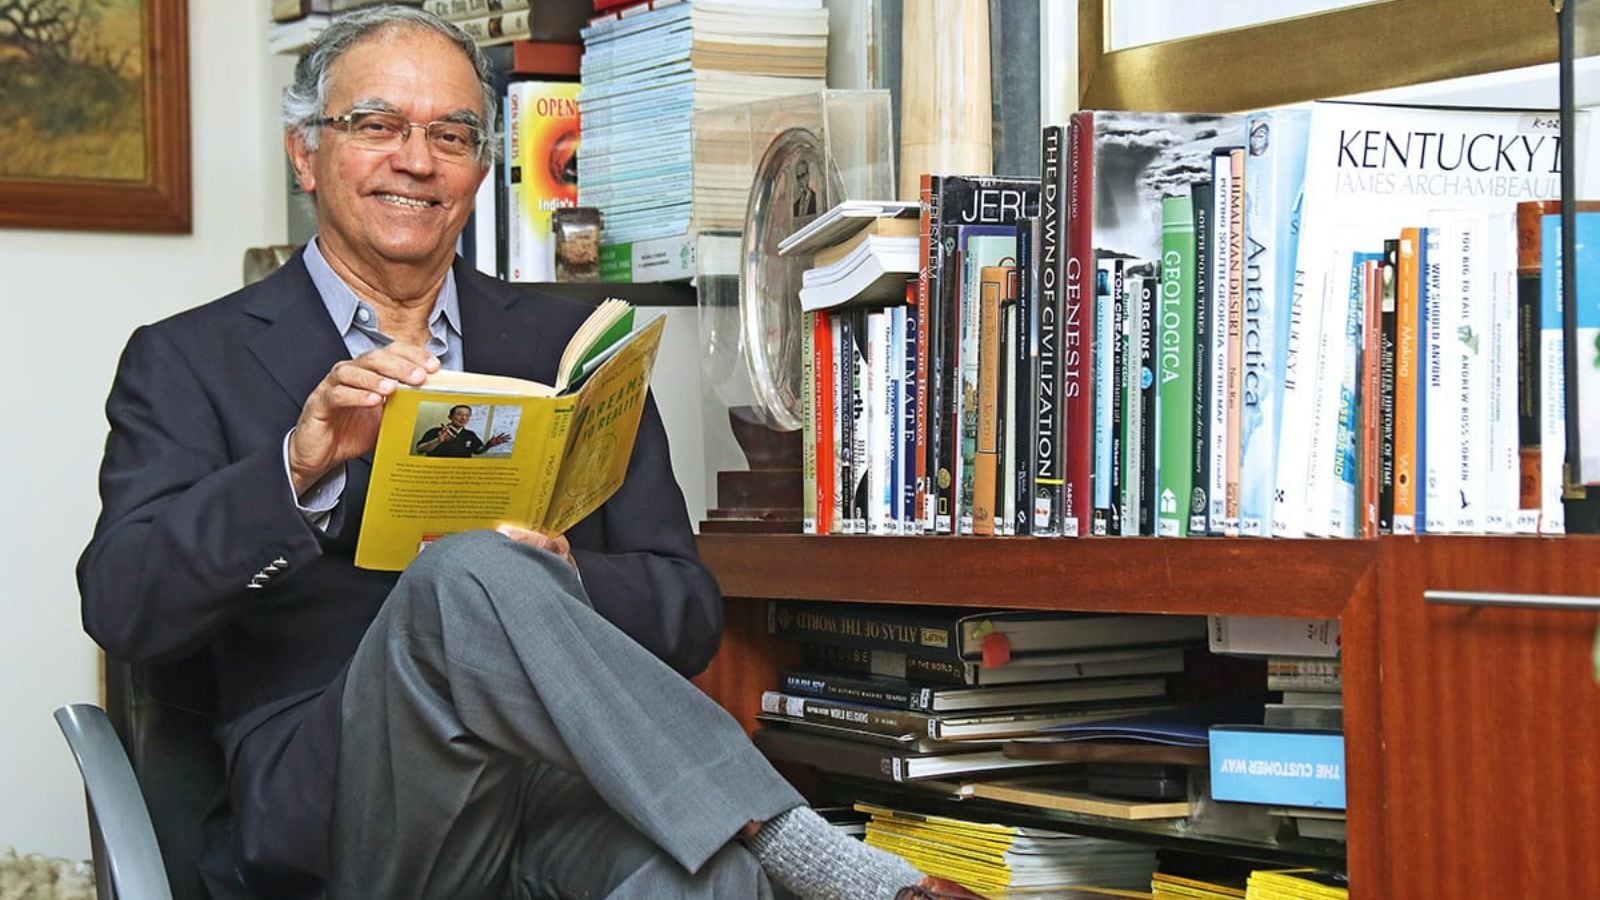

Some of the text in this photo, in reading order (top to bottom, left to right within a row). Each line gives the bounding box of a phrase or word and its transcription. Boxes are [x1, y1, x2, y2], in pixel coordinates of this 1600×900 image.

[1338, 130, 1545, 173] KENTUCKY
[1219, 177, 1228, 227] PUTTING
[1336, 174, 1396, 198] JAMES
[1197, 209, 1206, 335] SOUTH POLAR TIMES
[1217, 232, 1228, 279] SOUTH
[1229, 175, 1242, 339] HIMALAYAN DESERT
[1461, 230, 1471, 320] TOO BIG TO FAIL
[918, 266, 928, 331] WILDLIFE
[1038, 132, 1057, 478] THE DAWN OF CIVILIZATION
[1114, 270, 1123, 302] TOM
[1065, 257, 1081, 398] GENESIS
[1113, 303, 1122, 352] CREAN
[1141, 288, 1152, 359] ORIGINS
[1162, 250, 1182, 383] GEOLOGICA
[1216, 283, 1227, 348] GEORGIA
[1244, 237, 1267, 409] Antarctica
[1431, 262, 1441, 389] WHY SHOULD ANYONE
[1398, 325, 1412, 377] Making
[853, 349, 865, 420] eaarth
[904, 317, 917, 444] CLIMATE
[917, 379, 926, 447] HIMALAYAS
[1216, 398, 1224, 424] MAP
[1384, 394, 1393, 440] HISTORY
[1460, 354, 1469, 482] ANDREW ROSS SORKIN
[1384, 444, 1393, 459] OF
[1384, 463, 1393, 486] TIME
[797, 612, 838, 635] WORLD
[841, 618, 863, 637] THE
[866, 622, 880, 639] OF
[882, 623, 918, 643] ATLAS
[1220, 757, 1341, 780] THE CUSTOMER WAY
